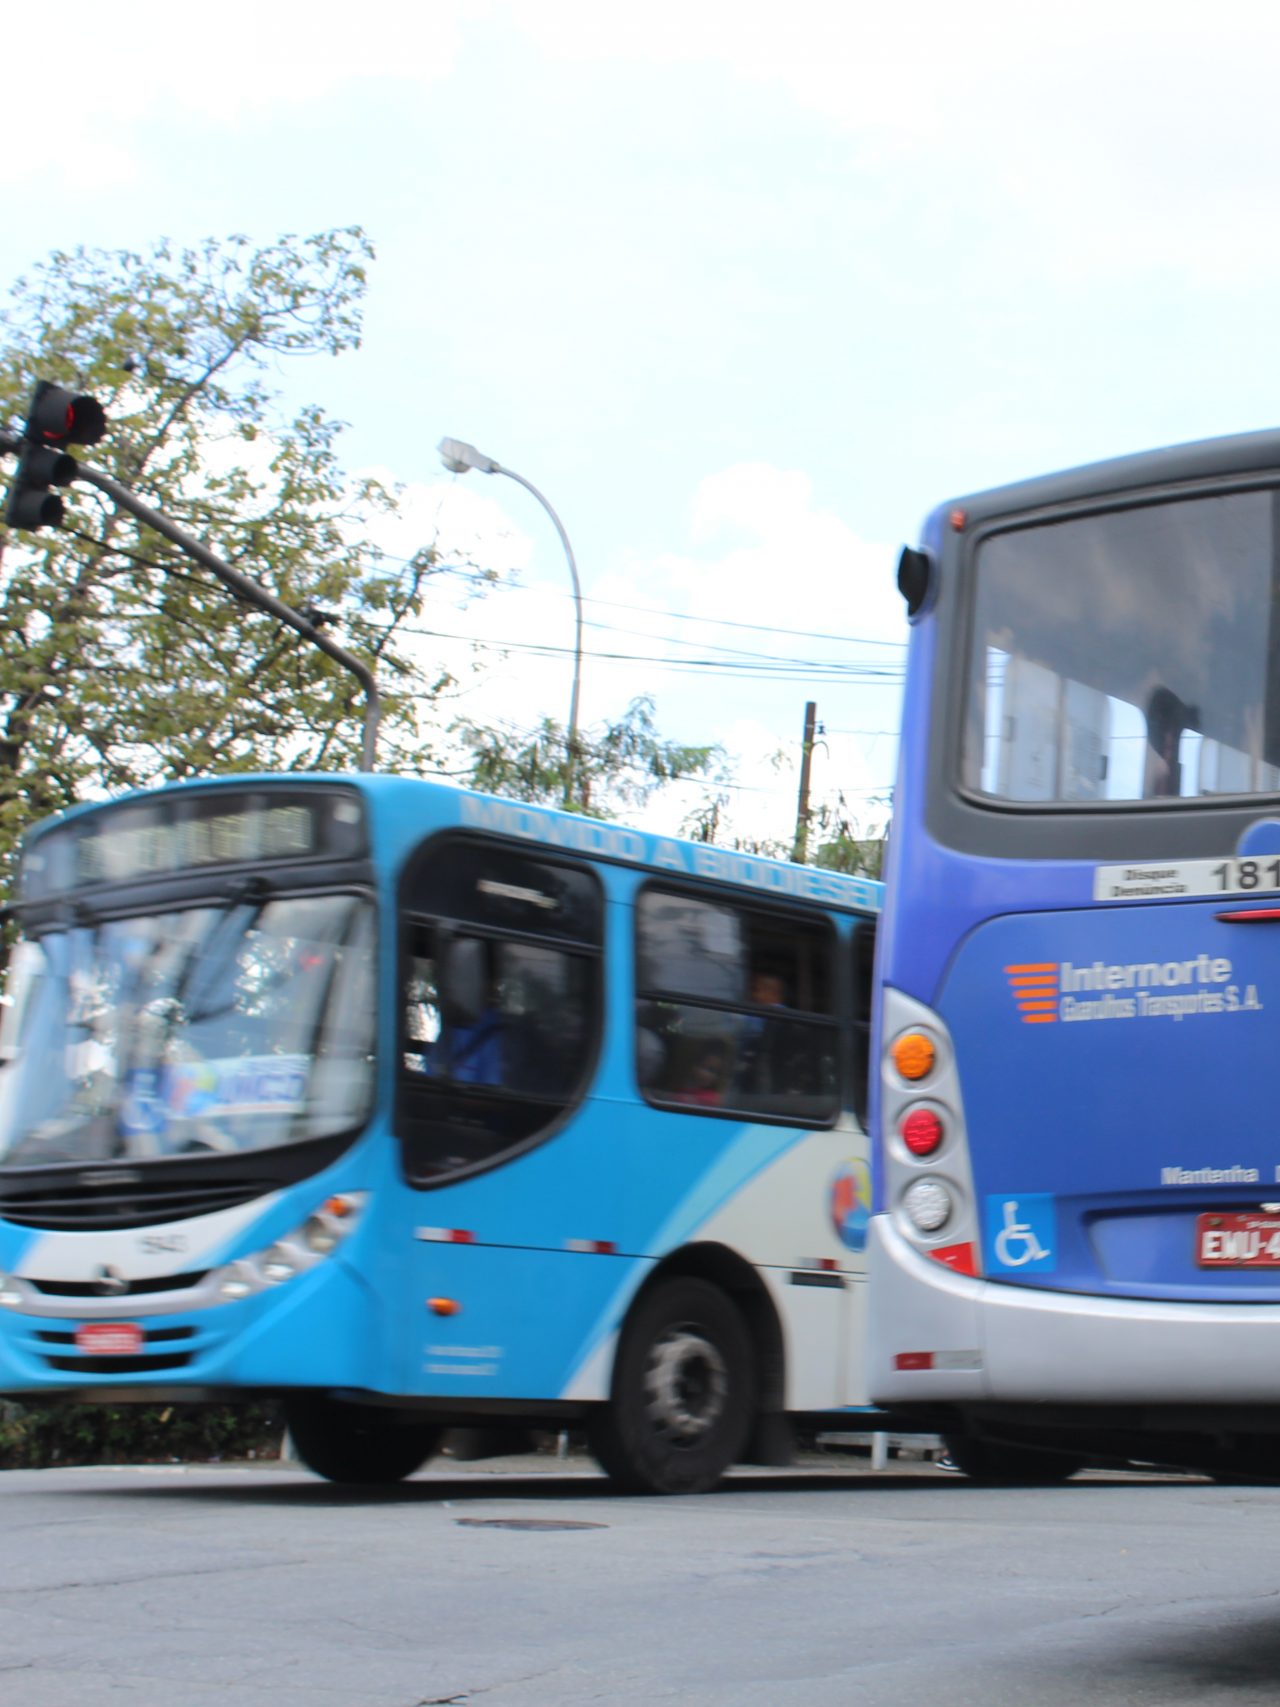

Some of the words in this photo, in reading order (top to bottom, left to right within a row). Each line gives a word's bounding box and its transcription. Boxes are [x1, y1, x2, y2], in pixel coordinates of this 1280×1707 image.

[652, 841, 687, 874] A
[1060, 953, 1232, 992] Internorte
[1161, 1165, 1259, 1185] Mantenha
